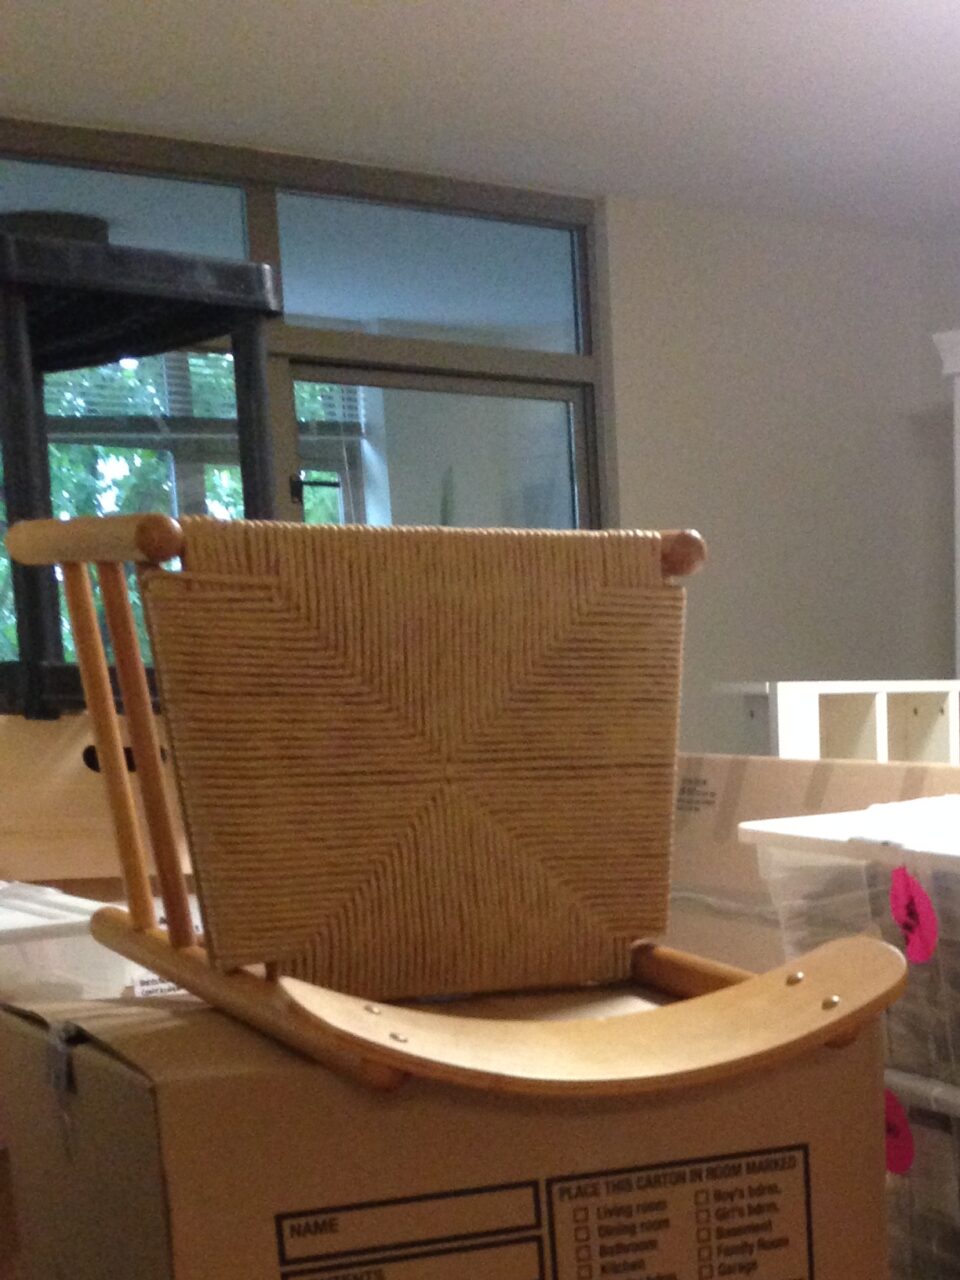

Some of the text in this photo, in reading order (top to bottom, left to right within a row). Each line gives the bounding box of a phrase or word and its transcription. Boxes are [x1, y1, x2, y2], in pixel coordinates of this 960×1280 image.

[558, 1155, 797, 1202] PLACE THIS CARTON IN ROOM MARKED
[289, 1217, 339, 1239] NAME
